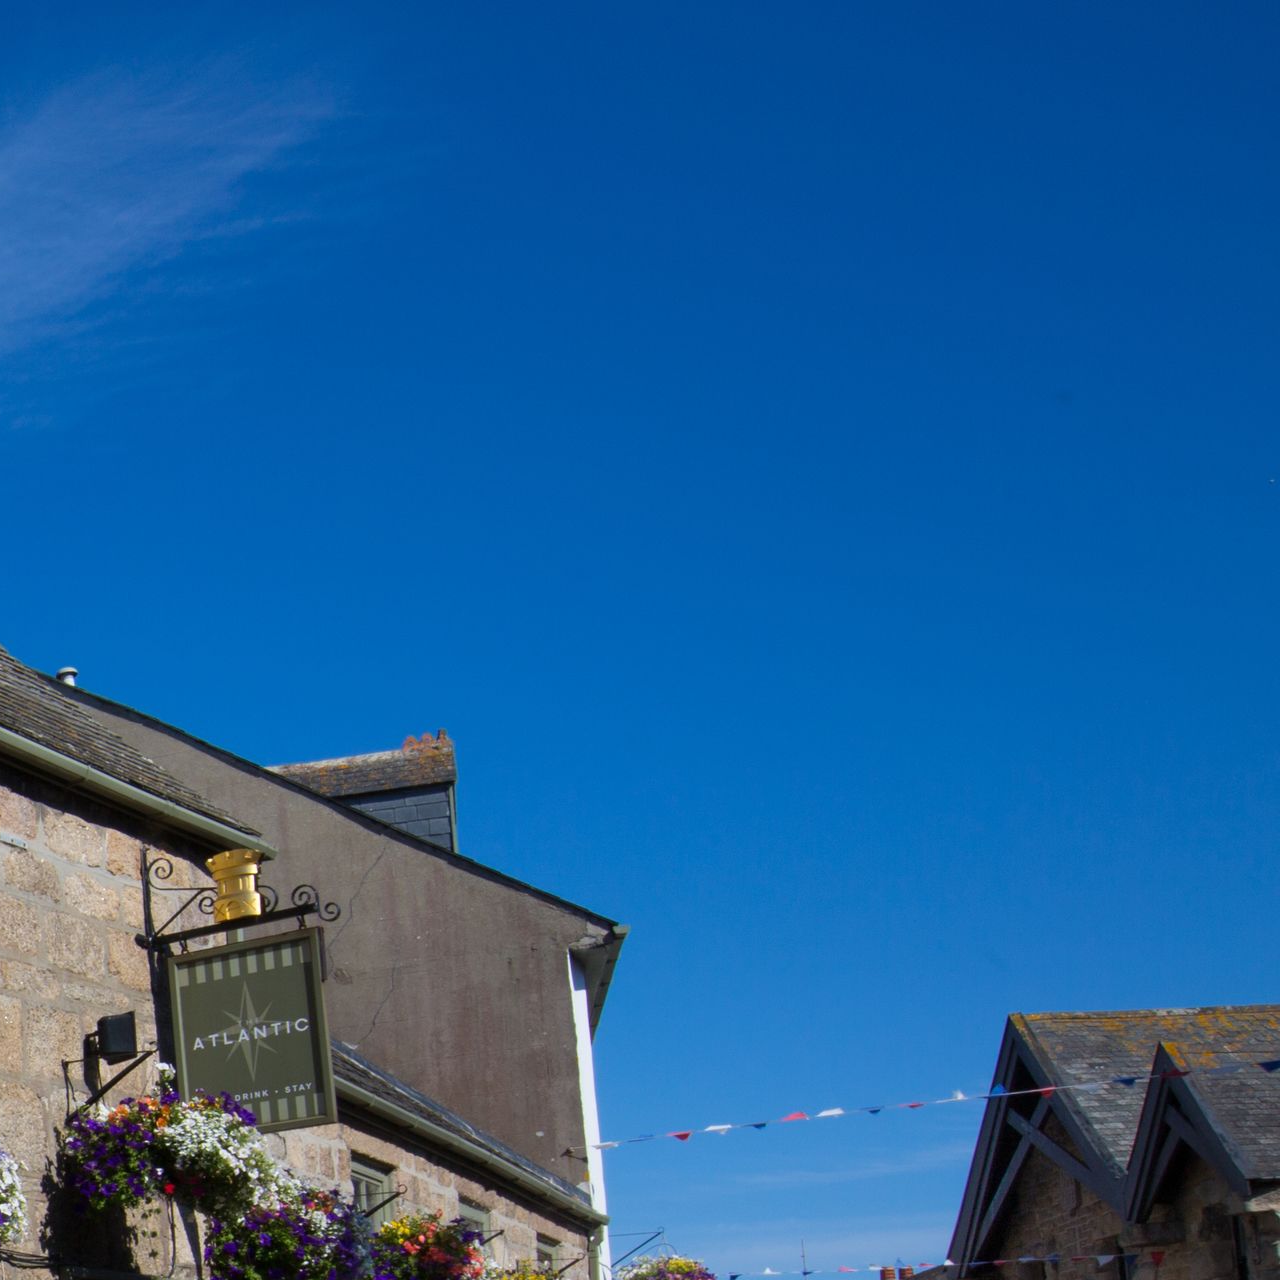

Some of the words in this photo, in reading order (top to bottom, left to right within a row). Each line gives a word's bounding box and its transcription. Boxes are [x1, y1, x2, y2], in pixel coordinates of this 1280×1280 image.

[193, 1017, 310, 1051] ATLANTIC
[235, 1089, 269, 1102] DRINK
[284, 1082, 313, 1094] STAY
